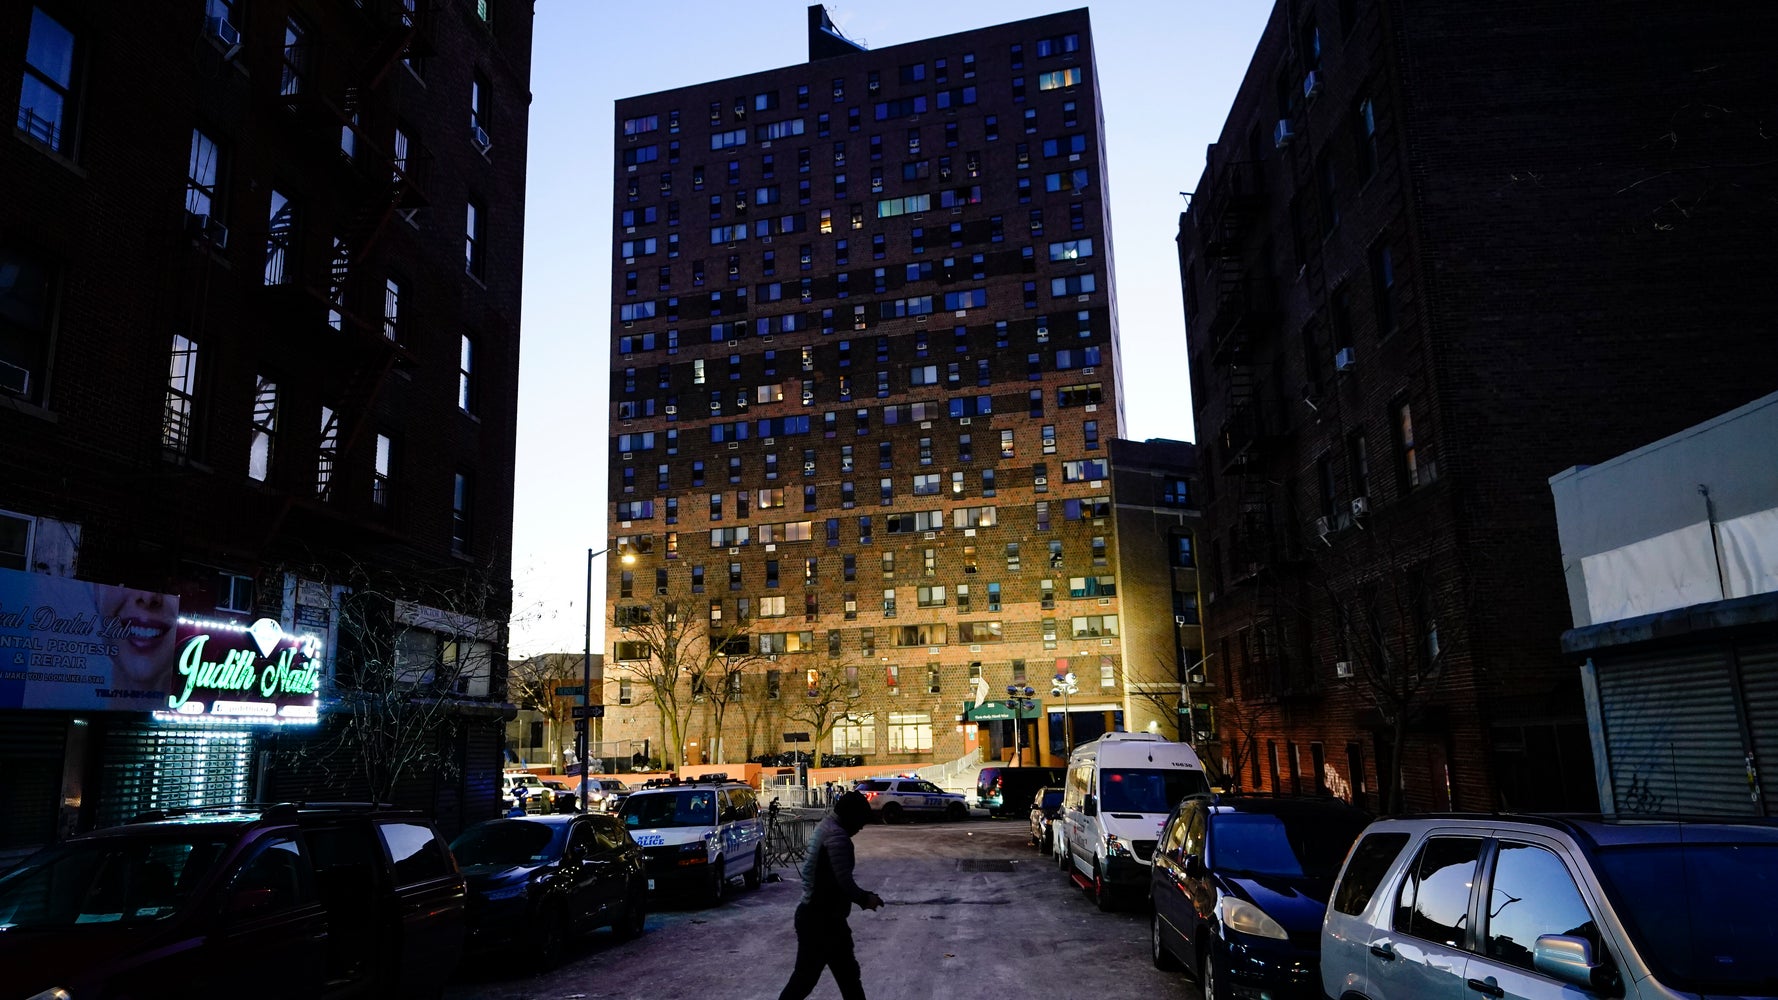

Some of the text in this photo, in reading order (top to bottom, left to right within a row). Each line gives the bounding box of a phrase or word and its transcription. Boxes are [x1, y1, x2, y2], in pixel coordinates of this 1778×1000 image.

[28, 606, 98, 635] Dental
[97, 616, 132, 640] Lab
[47, 639, 120, 656] PROTESIS
[13, 652, 87, 669] & REPAIR
[168, 634, 319, 709] Judith Nails
[638, 838, 665, 846] OLICE
